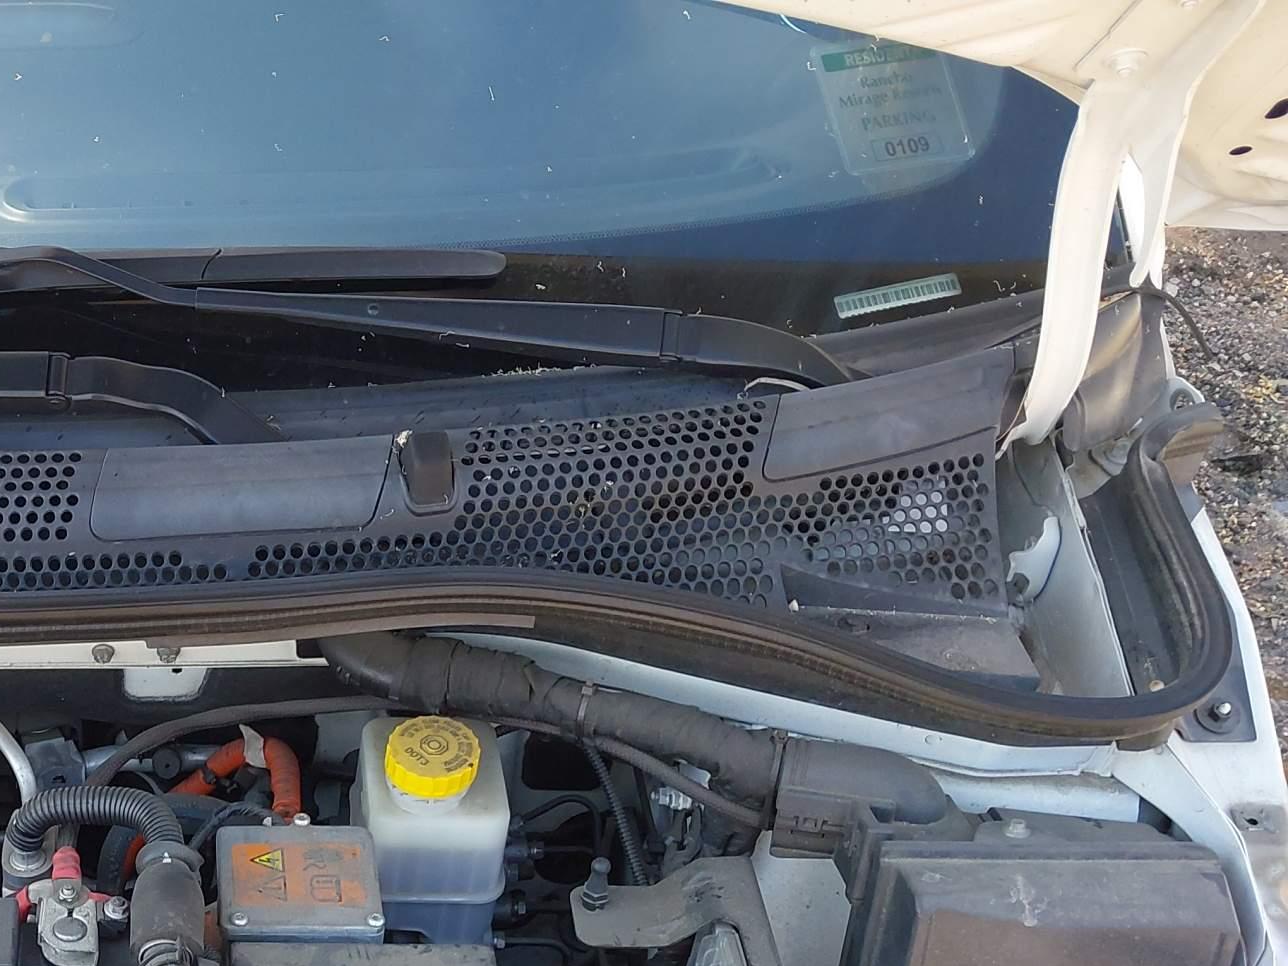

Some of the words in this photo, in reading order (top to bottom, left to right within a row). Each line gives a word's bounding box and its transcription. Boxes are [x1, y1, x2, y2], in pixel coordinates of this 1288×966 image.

[844, 48, 911, 66] RESID
[860, 71, 912, 88] Rancho
[839, 92, 889, 109] Mirage
[860, 111, 936, 131] PARKING
[885, 136, 931, 157] 0109
